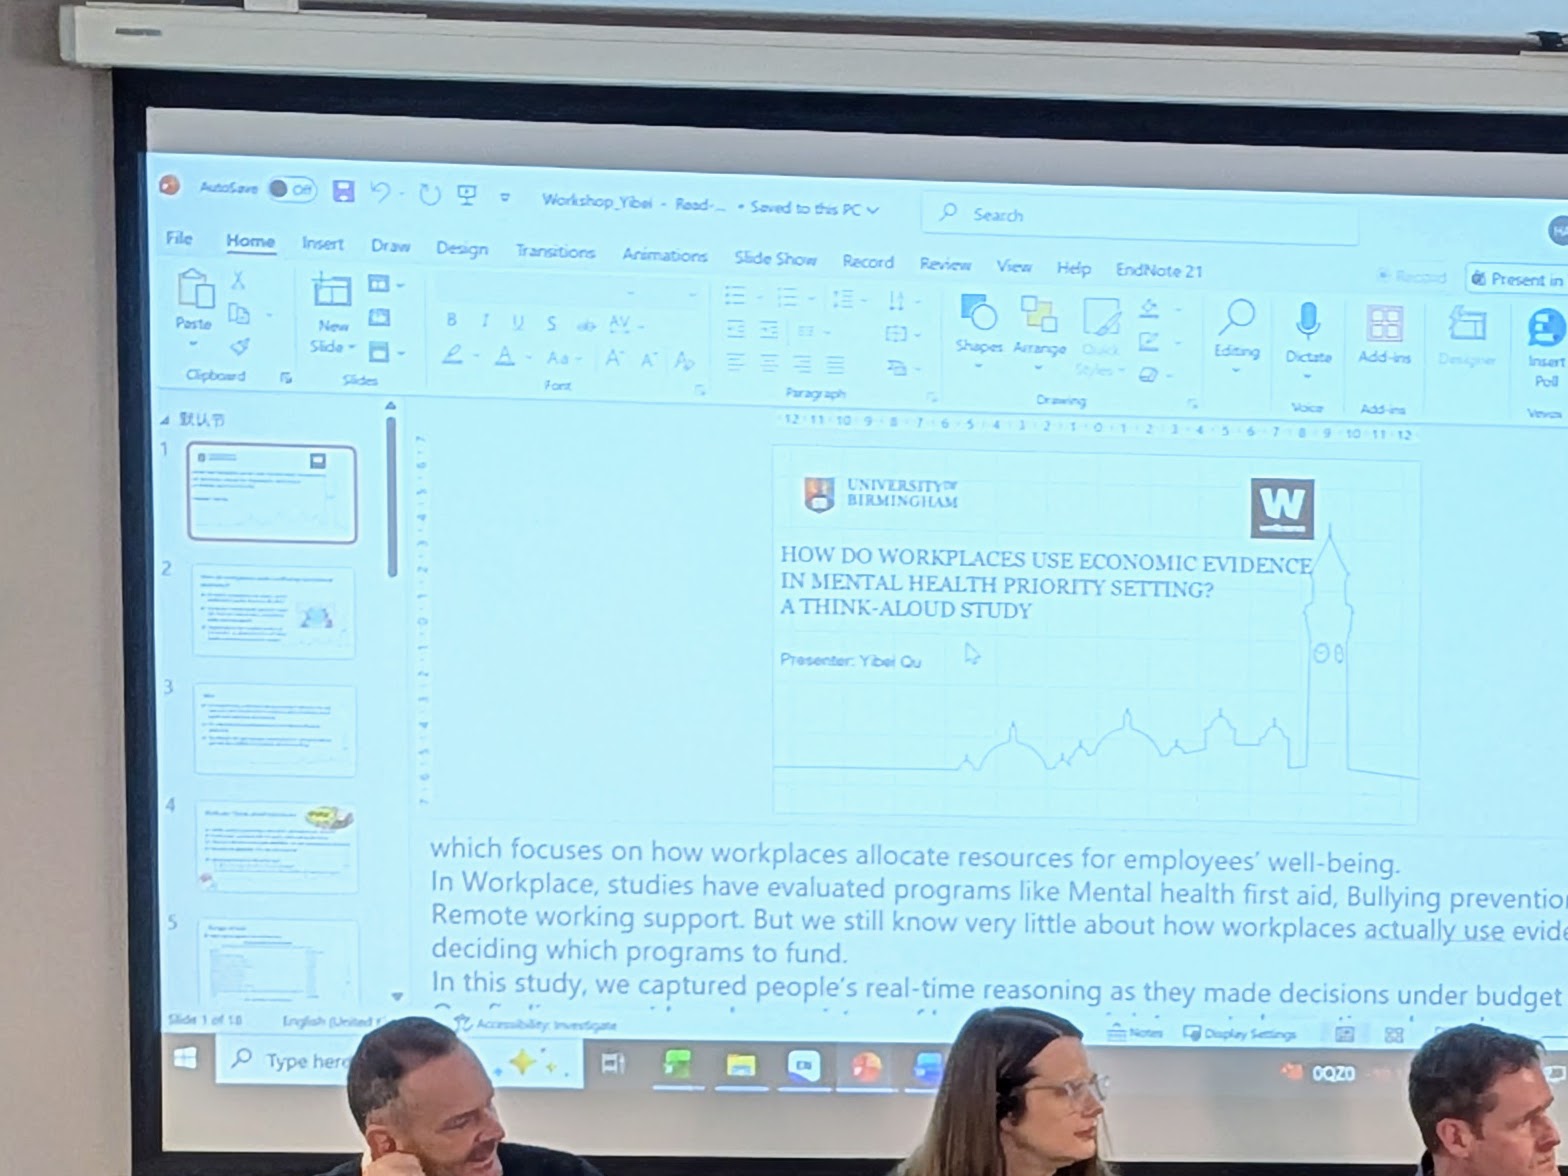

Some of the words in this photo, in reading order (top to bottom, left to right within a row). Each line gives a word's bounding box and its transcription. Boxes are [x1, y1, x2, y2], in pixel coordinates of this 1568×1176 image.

[200, 181, 258, 195] AutoSave
[292, 183, 313, 195] Off
[751, 201, 792, 215] Saved
[796, 203, 810, 215] to
[815, 202, 838, 216] this
[842, 204, 862, 217] PC
[973, 208, 1024, 222] Search
[166, 231, 192, 246] File
[227, 234, 275, 248] Home
[302, 236, 344, 251] Insert
[372, 239, 411, 253] Draw
[437, 241, 488, 260] Design
[516, 244, 596, 259] Transitions
[623, 248, 708, 263] Animations
[735, 251, 771, 265] Slide
[776, 252, 817, 267] Show
[843, 254, 894, 269] Record
[920, 257, 972, 272] Review
[997, 259, 1032, 273] View
[1057, 262, 1092, 279] Help
[1117, 263, 1181, 278] EndNote
[1185, 264, 1202, 278] 21
[1491, 272, 1545, 288] Present
[1549, 273, 1563, 288] in
[176, 317, 212, 330] Paste
[319, 321, 349, 332] New
[311, 340, 343, 353] Slide
[956, 340, 1002, 356] Shapes
[1014, 342, 1067, 358] Arrange
[1215, 345, 1260, 360] Editing
[1287, 350, 1331, 363] Dictate
[1358, 350, 1412, 364] Add-ins
[1529, 355, 1566, 369] Insert
[186, 369, 246, 384] Clipboard
[342, 374, 378, 387] Slides
[1535, 374, 1559, 388] Poll
[786, 388, 846, 401] Paragraph
[1036, 394, 1087, 409] Drawing
[1361, 404, 1406, 416] Add-ins
[848, 479, 943, 492] UNIVERSITY
[848, 495, 958, 508] BIRMINGHAM
[1260, 488, 1305, 520] W
[781, 546, 835, 563] HOW
[841, 547, 872, 564] DO
[878, 548, 1025, 568] WORKPLACES
[1033, 553, 1072, 569] USE
[1080, 553, 1198, 572] ECONOMIC
[1203, 556, 1312, 574] EVIDENCE
[161, 561, 172, 576] 2
[781, 573, 805, 589] IN
[812, 574, 902, 591] MENTAL
[909, 575, 996, 593] HEALTH
[1004, 577, 1106, 595] PRIORITY
[1111, 580, 1214, 598] SETTING?
[781, 599, 795, 615] A
[799, 599, 955, 617] THINK-ALOUD
[961, 602, 1033, 619] STUDY
[781, 653, 854, 667] Presenter:
[859, 655, 895, 668] Yibei
[900, 656, 921, 668] Qu
[164, 679, 174, 694] 3
[165, 797, 175, 813] 4
[430, 836, 501, 859] which
[511, 838, 602, 861] focuses
[612, 845, 643, 861] on
[651, 840, 703, 862] how
[712, 843, 847, 869] workplaces
[855, 845, 950, 866] allocate
[958, 851, 1073, 869] resources
[1082, 847, 1115, 869] for
[1268, 853, 1401, 879] well-being.
[432, 871, 453, 892] In
[462, 871, 599, 899] Workplace,
[608, 874, 693, 895] studies
[703, 876, 759, 897] have
[768, 877, 884, 899] evaluated
[894, 883, 1012, 906] programs
[1019, 880, 1060, 902] like
[1069, 881, 1152, 903] Mental
[1161, 882, 1235, 904] health
[1243, 884, 1288, 905] first
[1296, 885, 1338, 908] aid,
[1347, 886, 1441, 912] Bullying
[168, 914, 178, 930] 5
[432, 904, 527, 925] Remote
[536, 906, 634, 933] working
[643, 909, 744, 934] support.
[753, 909, 793, 930] But
[802, 914, 835, 930] we
[844, 911, 884, 931] still
[892, 911, 957, 933] know
[965, 916, 1015, 939] very
[1024, 912, 1076, 934] little
[1084, 914, 1155, 935] about
[1163, 914, 1214, 936] how
[1223, 916, 1356, 942] workplaces
[1364, 918, 1457, 946] actually
[1464, 924, 1504, 941] use
[432, 938, 537, 965] deciding
[546, 939, 617, 961] which
[627, 942, 744, 967] programs
[752, 944, 777, 963] to
[786, 941, 847, 963] fund.
[433, 971, 454, 992] In
[463, 971, 506, 992] this
[515, 973, 587, 999] study,
[596, 977, 629, 994] we
[639, 975, 747, 1000] captured
[866, 978, 974, 999] real-time
[983, 980, 1101, 1006] reasoning
[1110, 984, 1135, 1001] as
[1144, 980, 1196, 1006] they
[1204, 982, 1271, 1003] made
[1279, 983, 1389, 1005] decisions
[1398, 984, 1468, 1006] under
[1476, 985, 1562, 1013] budget
[211, 1014, 224, 1026] of
[283, 1015, 325, 1030] English
[1130, 1027, 1163, 1038] Notes
[1205, 1029, 1247, 1042] Display
[1251, 1029, 1296, 1041] Settings
[268, 1053, 308, 1073] Type
